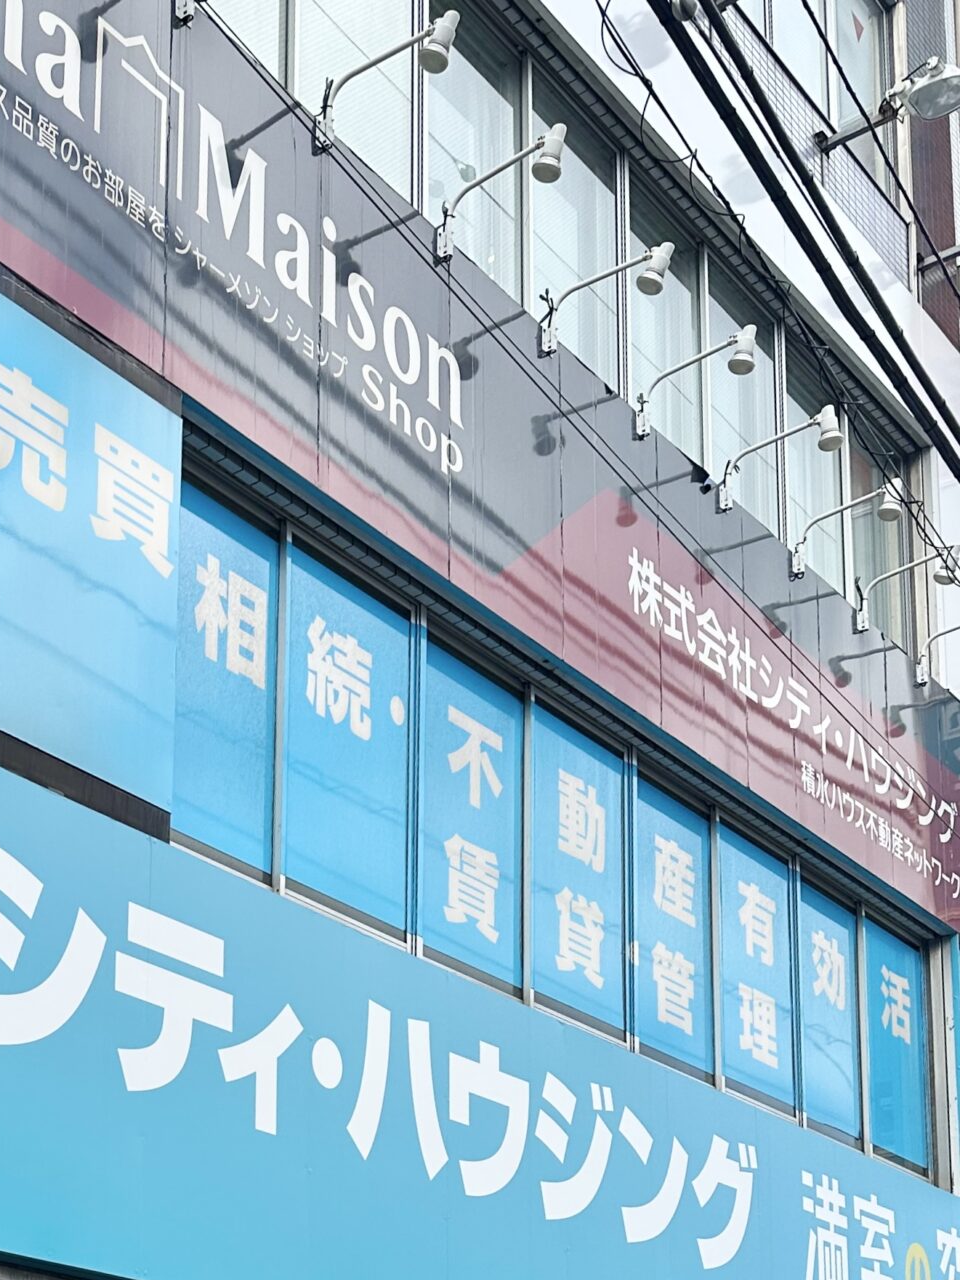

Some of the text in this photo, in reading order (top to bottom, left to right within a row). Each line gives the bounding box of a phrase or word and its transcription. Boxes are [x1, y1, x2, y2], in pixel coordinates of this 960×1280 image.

[175, 226, 280, 324] シャーメゾン
[286, 317, 349, 379] ショップ
[196, 103, 464, 429] Maison
[360, 364, 464, 474] Shop
[627, 547, 958, 843] 株式会社シティ・ハウジング
[800, 759, 960, 899] 積水ハウス不動産ネットワーク
